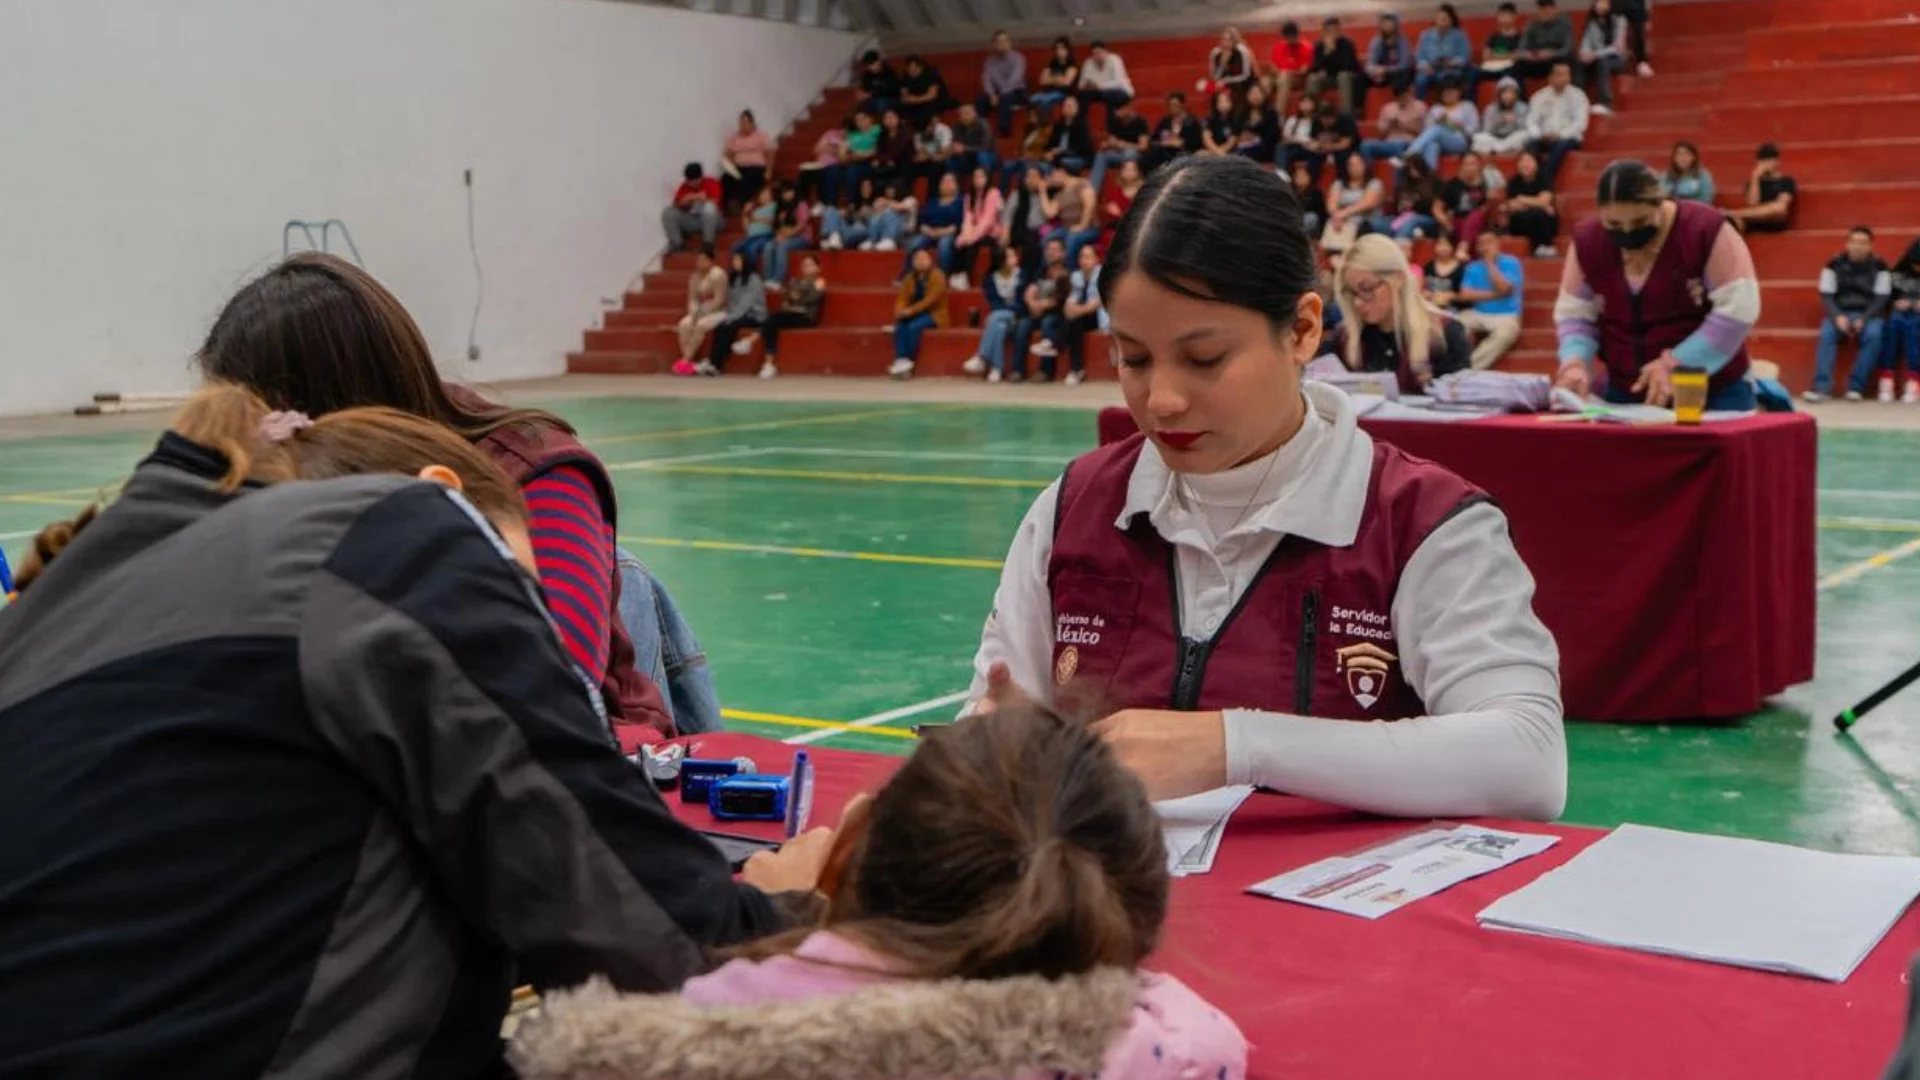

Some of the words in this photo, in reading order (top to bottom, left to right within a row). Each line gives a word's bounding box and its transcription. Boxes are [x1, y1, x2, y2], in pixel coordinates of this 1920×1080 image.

[1057, 612, 1090, 625] obierno
[1092, 614, 1105, 628] de
[1331, 605, 1388, 625] Servidor
[1345, 622, 1393, 640] Educac
